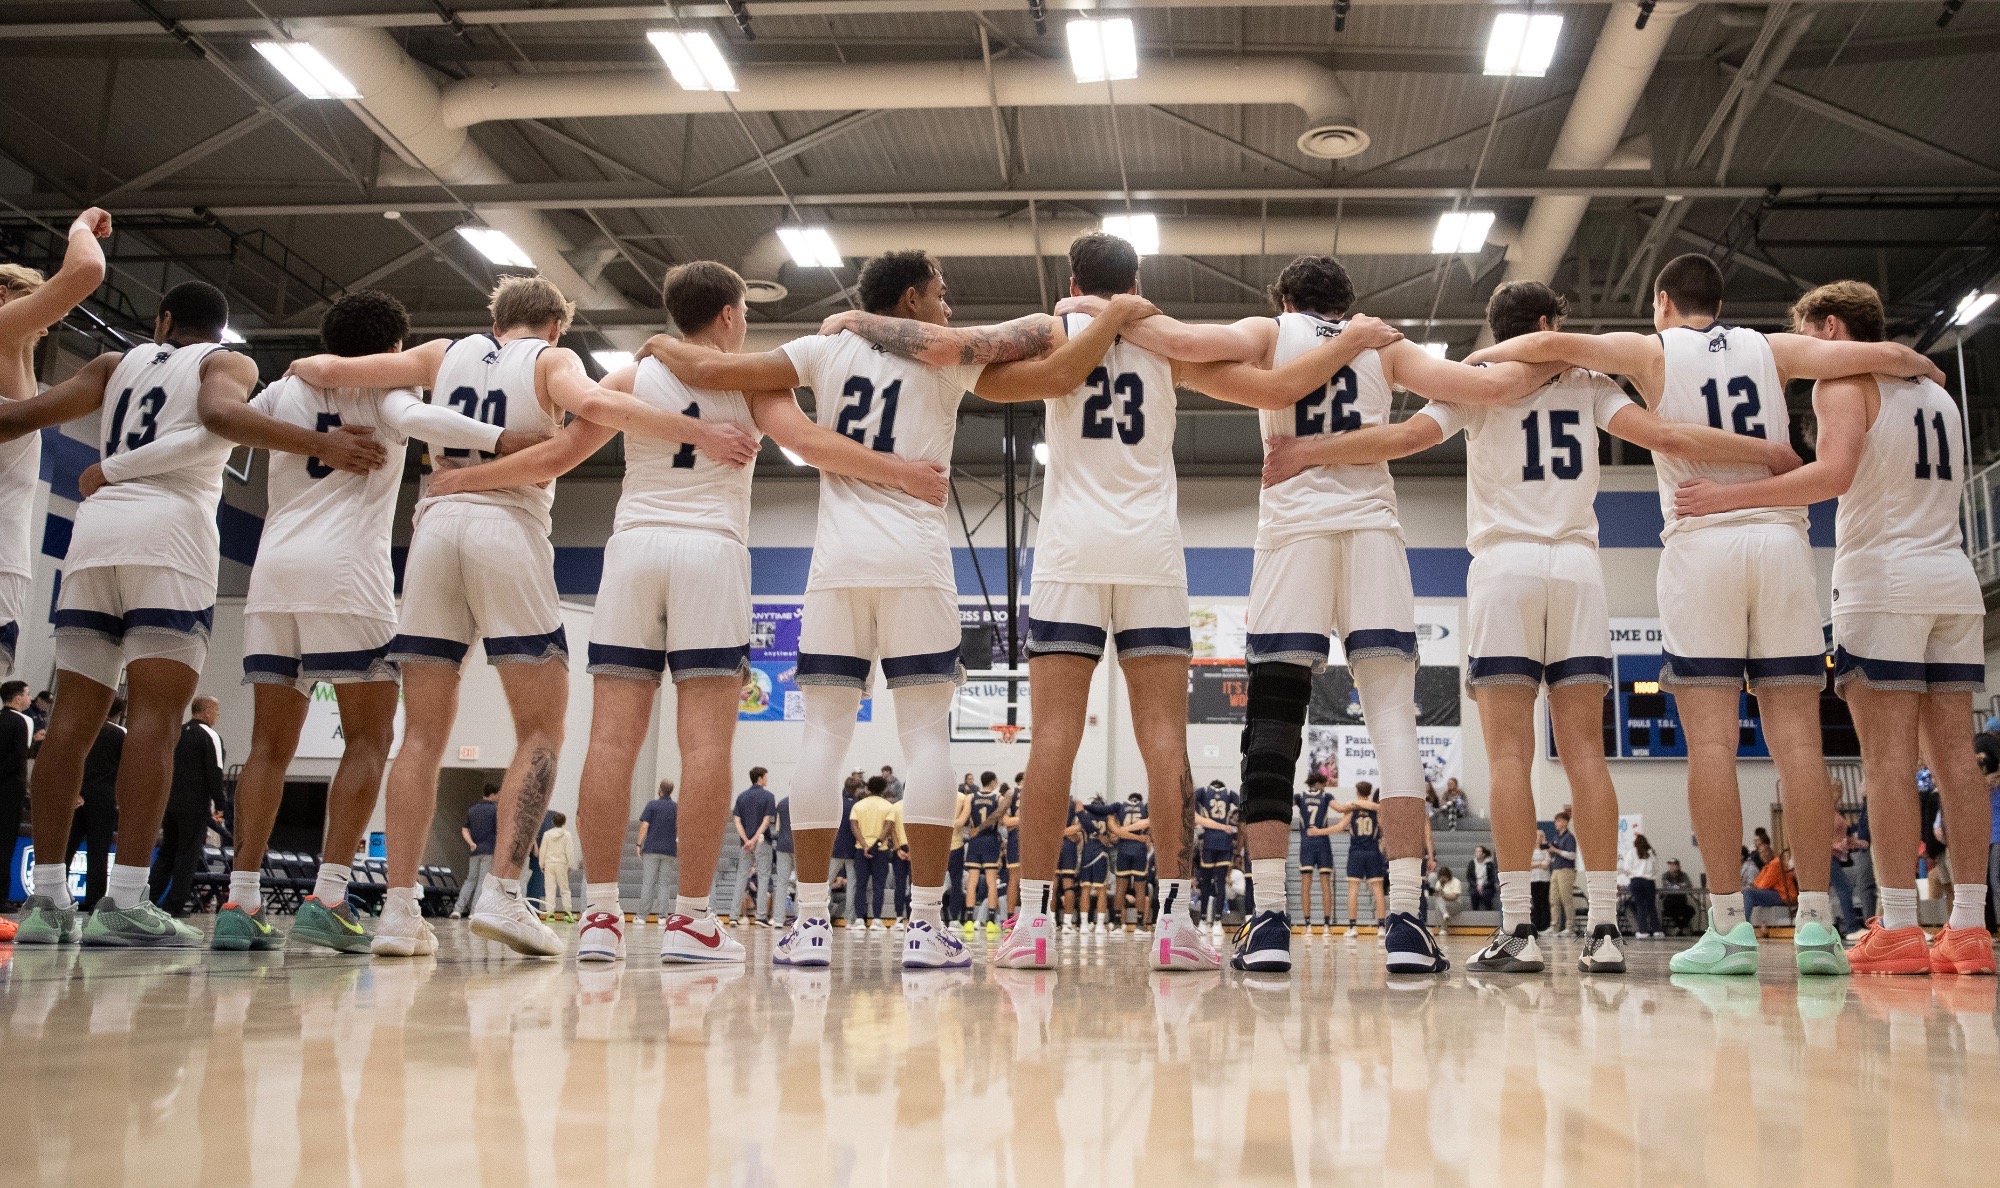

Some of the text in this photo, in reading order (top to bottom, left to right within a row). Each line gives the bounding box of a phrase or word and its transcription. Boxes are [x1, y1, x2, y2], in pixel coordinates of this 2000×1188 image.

[105, 386, 168, 458] 13
[671, 400, 700, 469] 1
[836, 374, 903, 453] 21
[1081, 364, 1146, 446] 23
[1295, 363, 1362, 437] 22
[1701, 374, 1767, 440] 12
[1521, 409, 1584, 482] 15
[1913, 407, 1952, 481] 11
[1628, 719, 1651, 728] FOULS
[1209, 798, 1227, 820] 23
[1307, 805, 1319, 826] 7
[1356, 816, 1373, 837] 10
